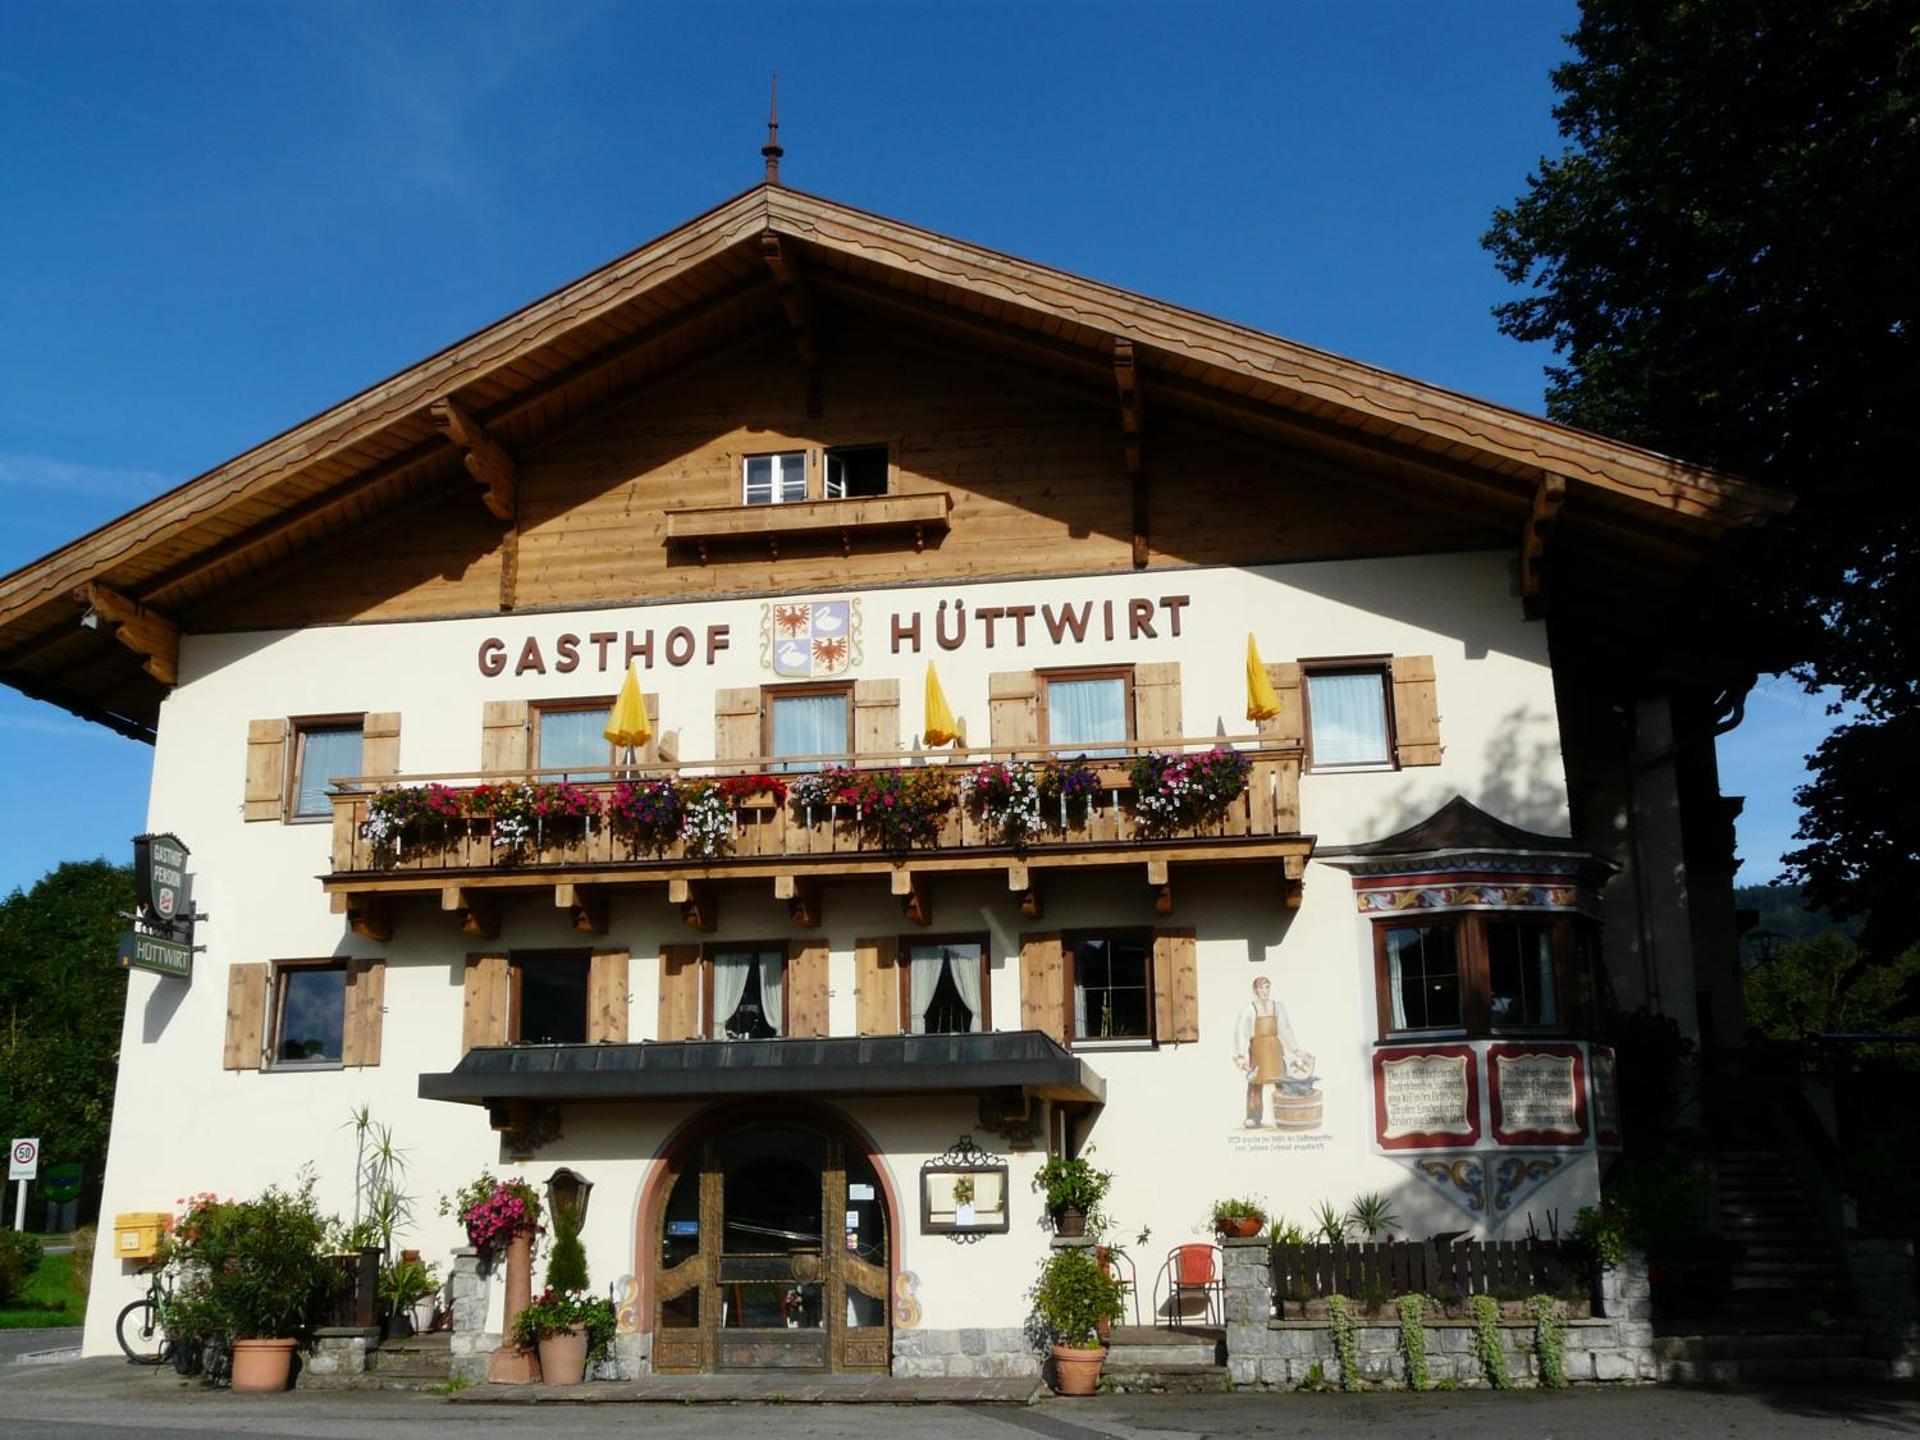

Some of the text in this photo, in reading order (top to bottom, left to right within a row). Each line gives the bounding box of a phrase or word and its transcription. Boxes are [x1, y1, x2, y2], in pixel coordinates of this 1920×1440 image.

[478, 595, 1191, 678] GASTHOF HÜTTWIRT
[154, 865, 182, 888] PENSION
[18, 1147, 31, 1159] 50
